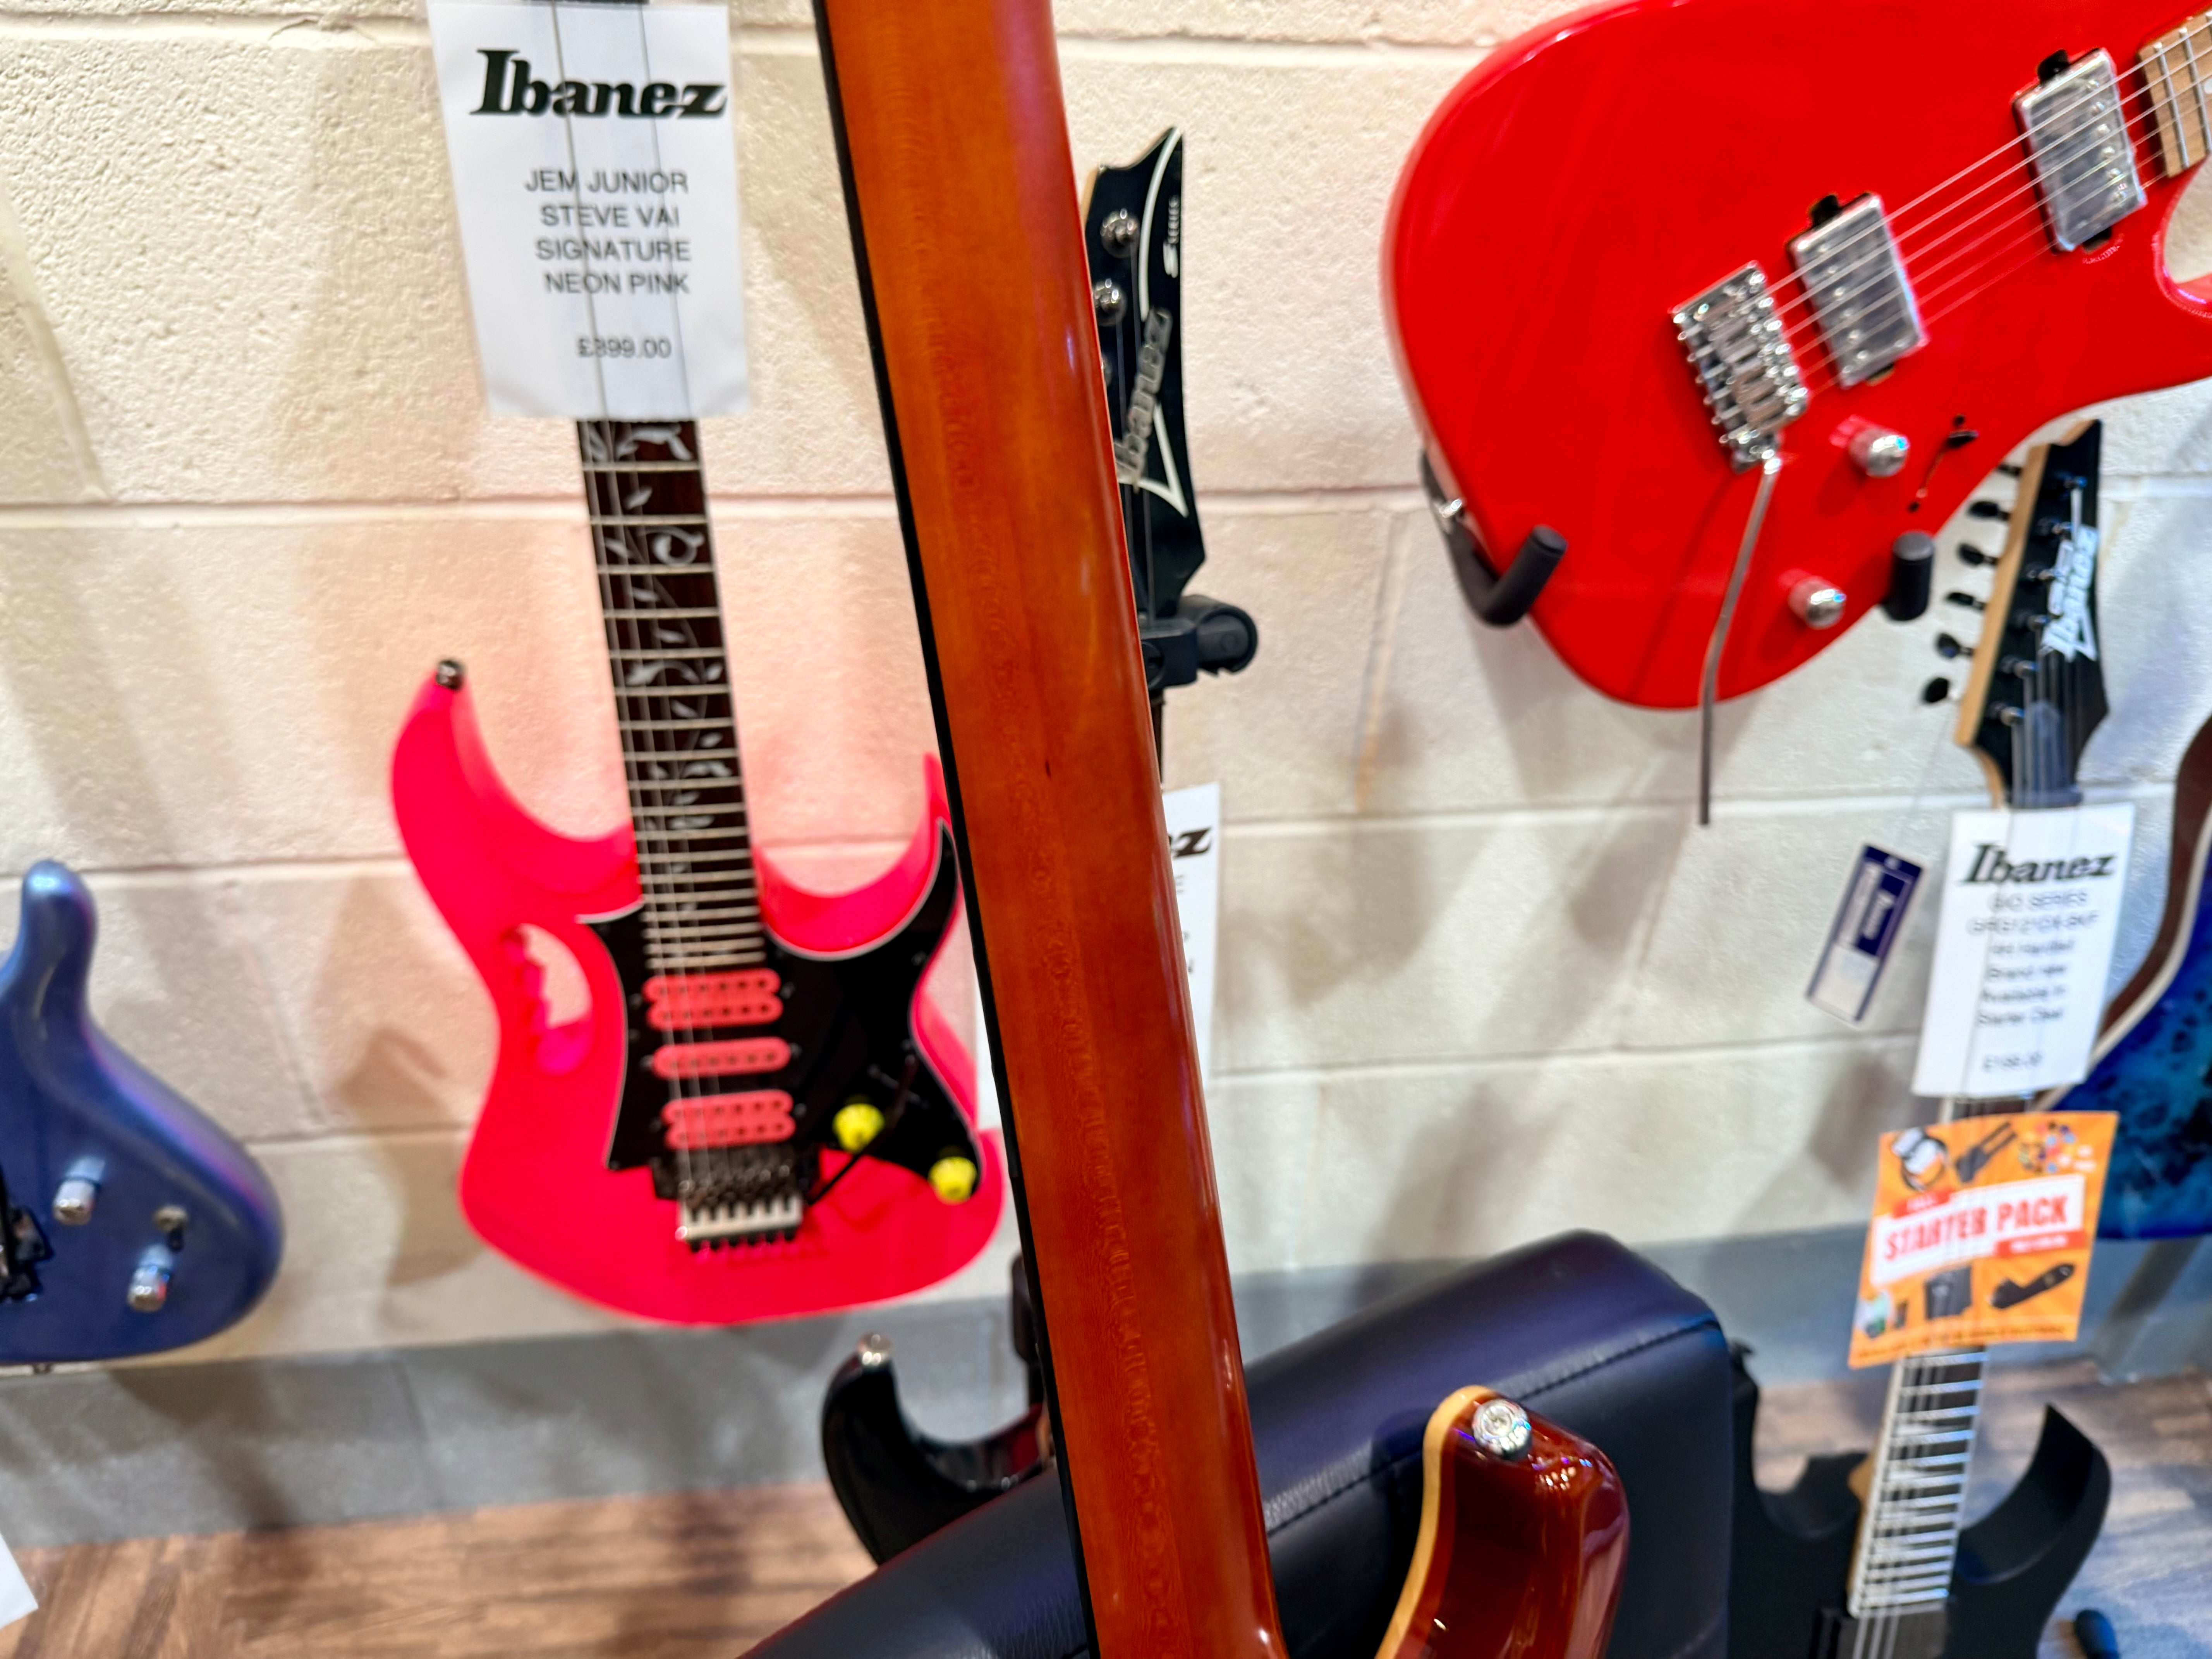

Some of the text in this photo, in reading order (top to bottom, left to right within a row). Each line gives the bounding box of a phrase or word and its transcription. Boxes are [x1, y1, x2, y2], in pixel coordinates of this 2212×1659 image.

[469, 48, 727, 118] Ibanez
[524, 170, 688, 193] JEM JUNIOR
[540, 204, 680, 228] STEVE VAI
[534, 239, 691, 261] SIGNATURE
[545, 272, 691, 295] NEON PINK
[1959, 842, 2117, 885] Ibanez
[1884, 1206, 1988, 1260] STARTER
[1996, 1195, 2068, 1232] PACK
